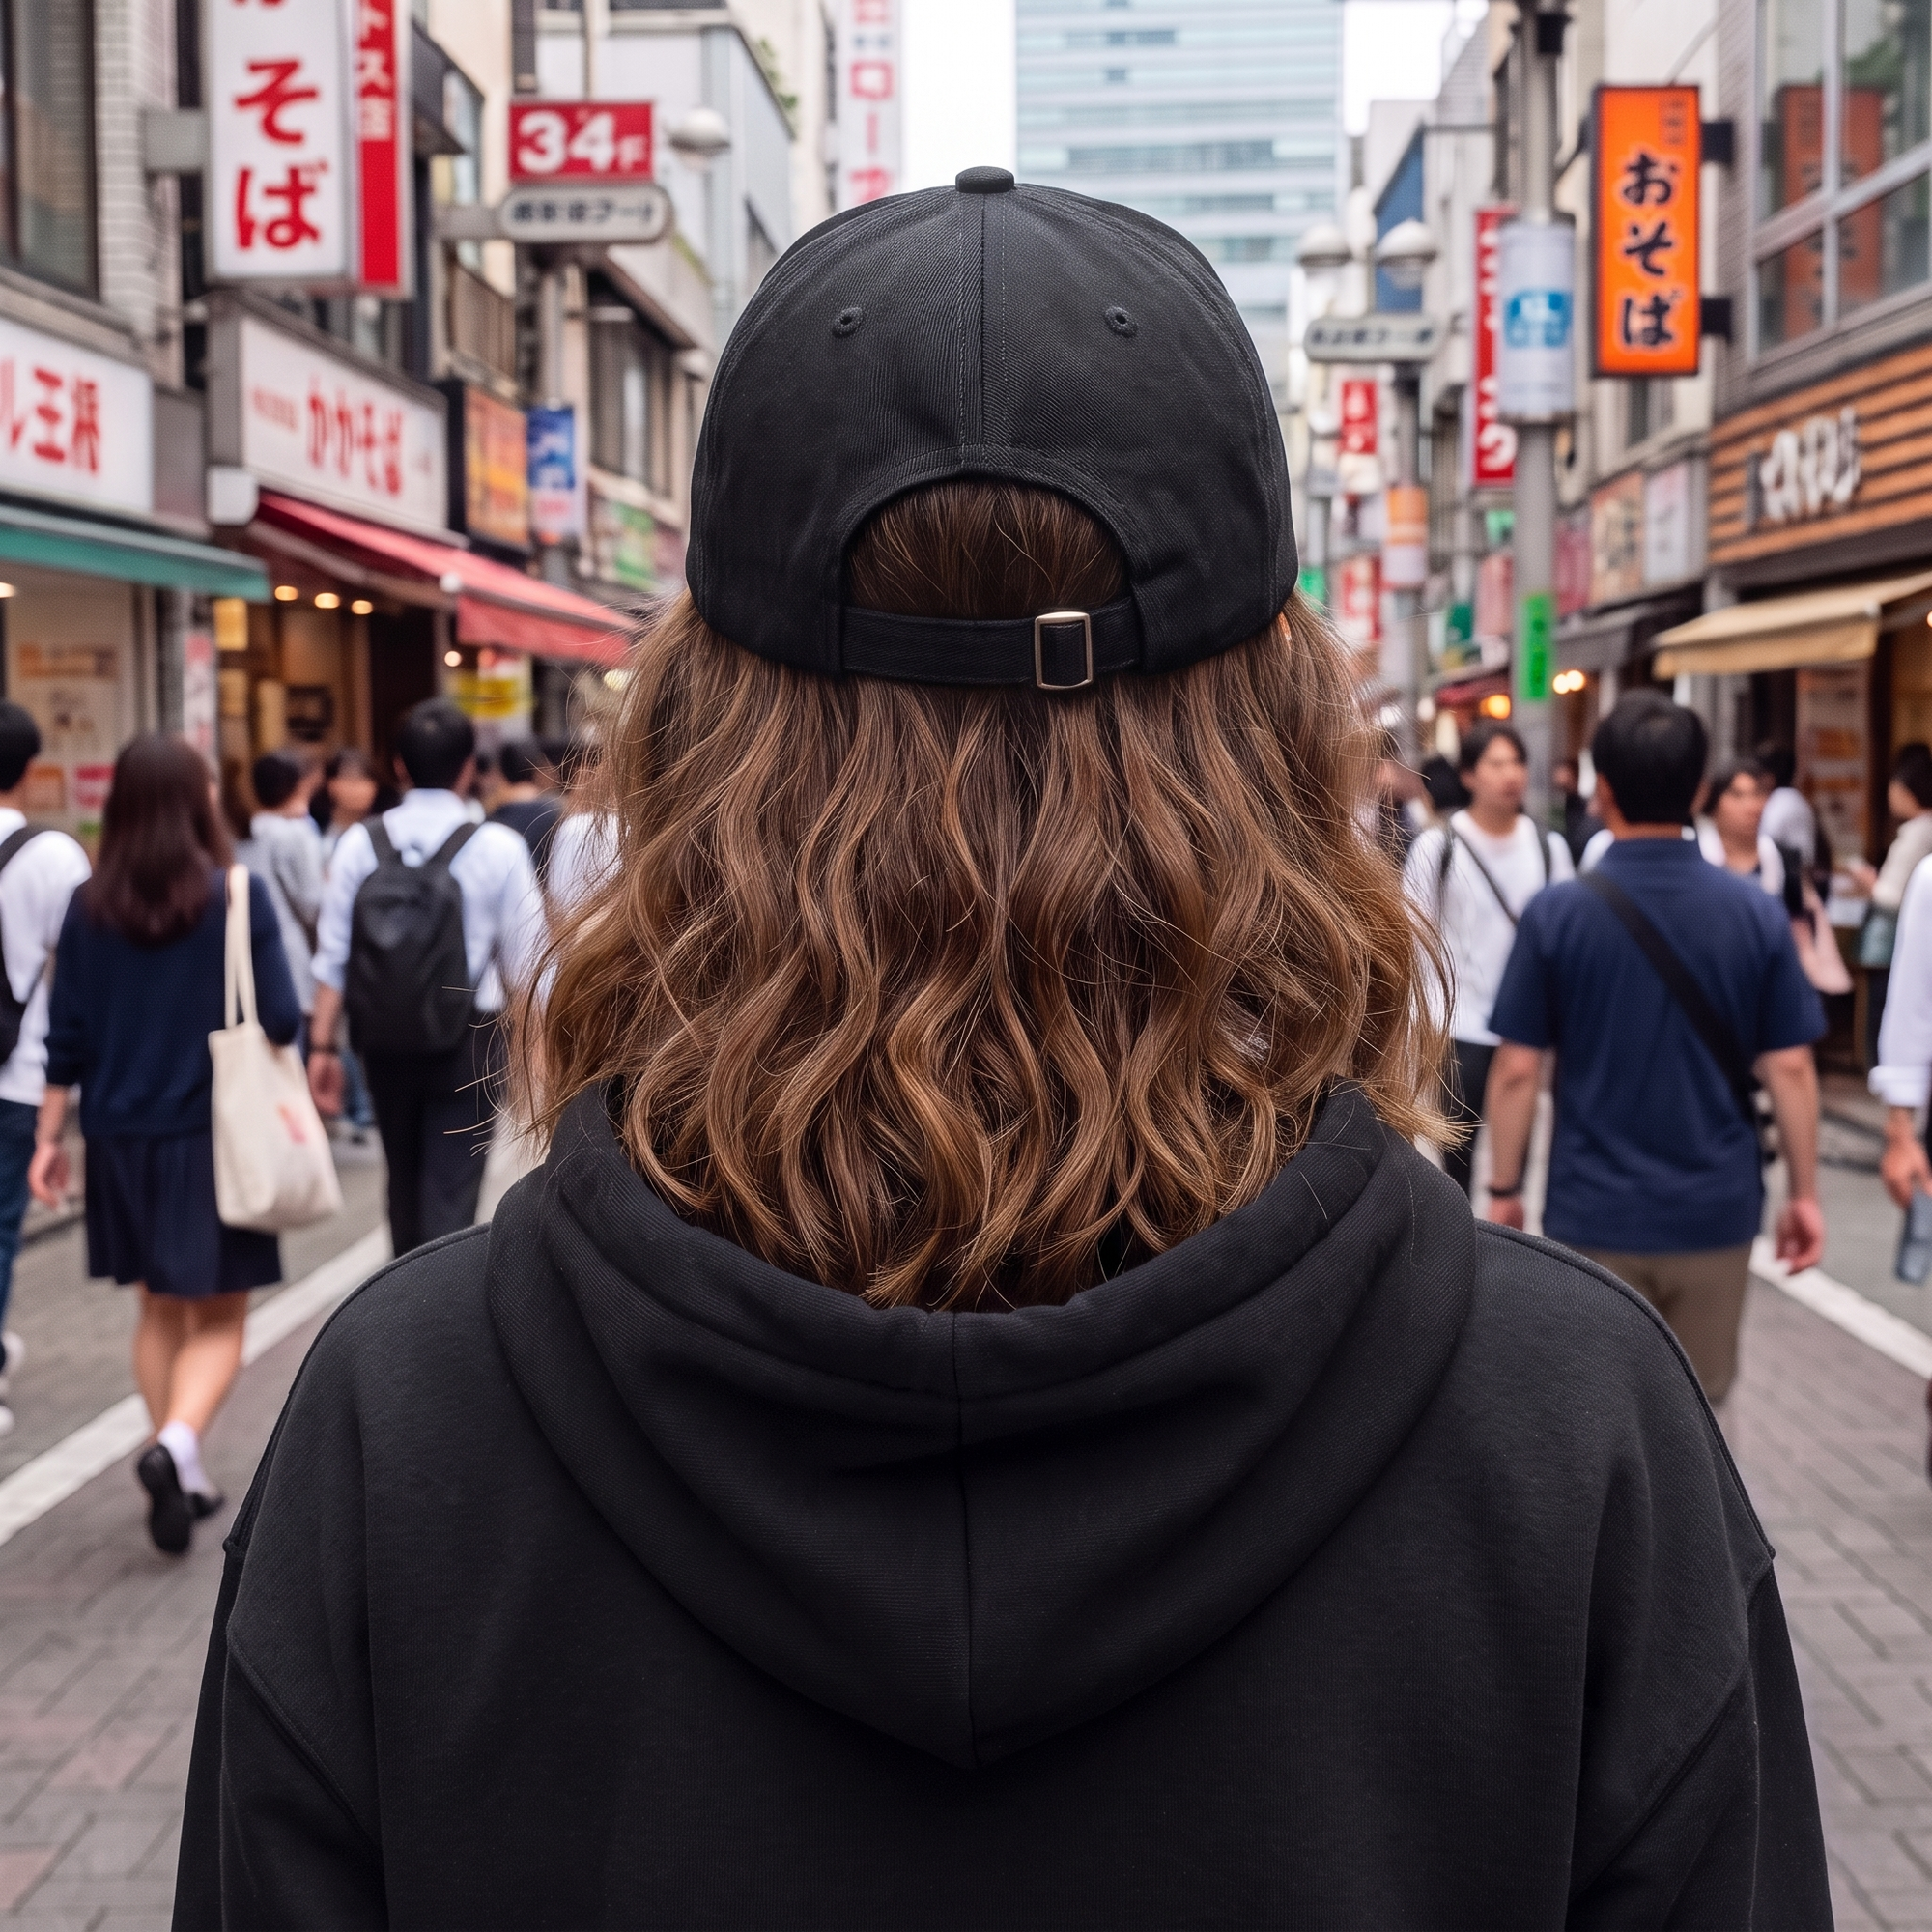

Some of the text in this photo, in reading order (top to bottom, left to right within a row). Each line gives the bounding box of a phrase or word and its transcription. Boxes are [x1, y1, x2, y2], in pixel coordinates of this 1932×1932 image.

[233, 0, 327, 250] そば
[1622, 152, 1682, 347] おそば
